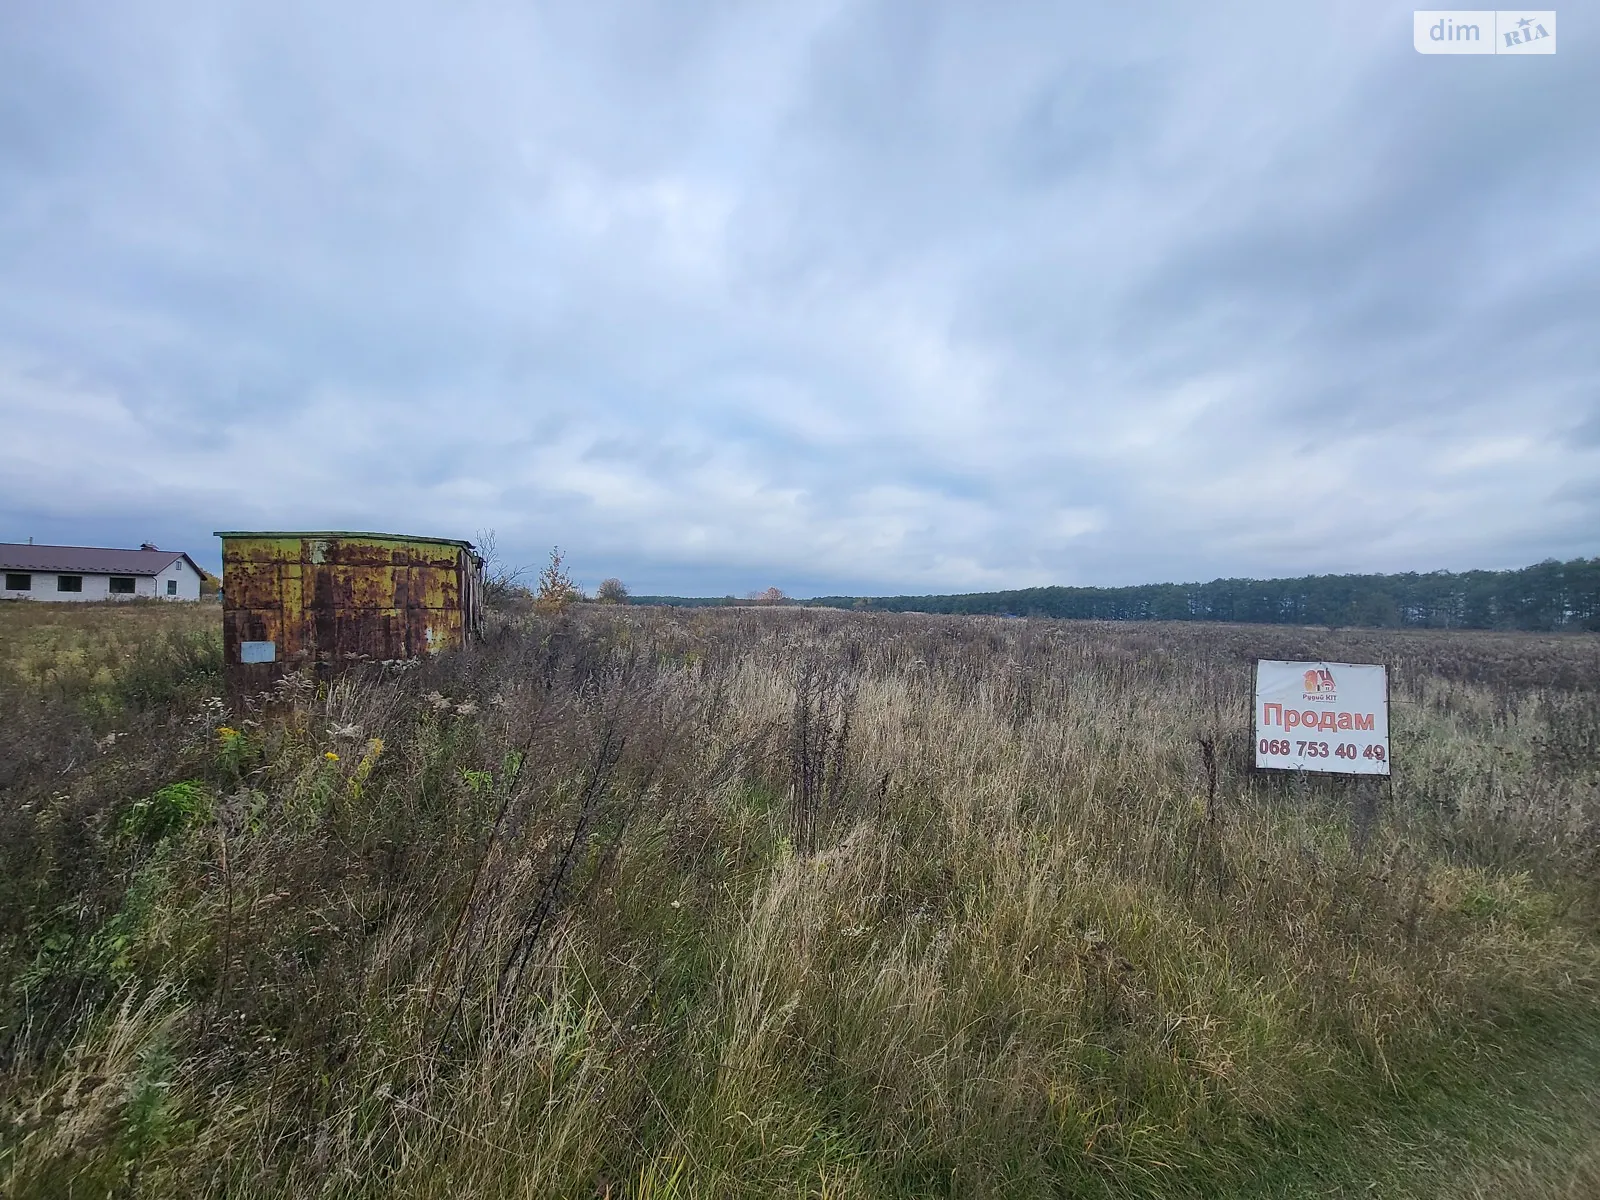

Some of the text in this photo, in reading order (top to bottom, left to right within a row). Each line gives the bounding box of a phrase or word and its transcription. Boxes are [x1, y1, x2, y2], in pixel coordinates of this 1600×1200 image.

[1263, 702, 1375, 733] Продам
[1259, 738, 1386, 761] 068 753 40 49
